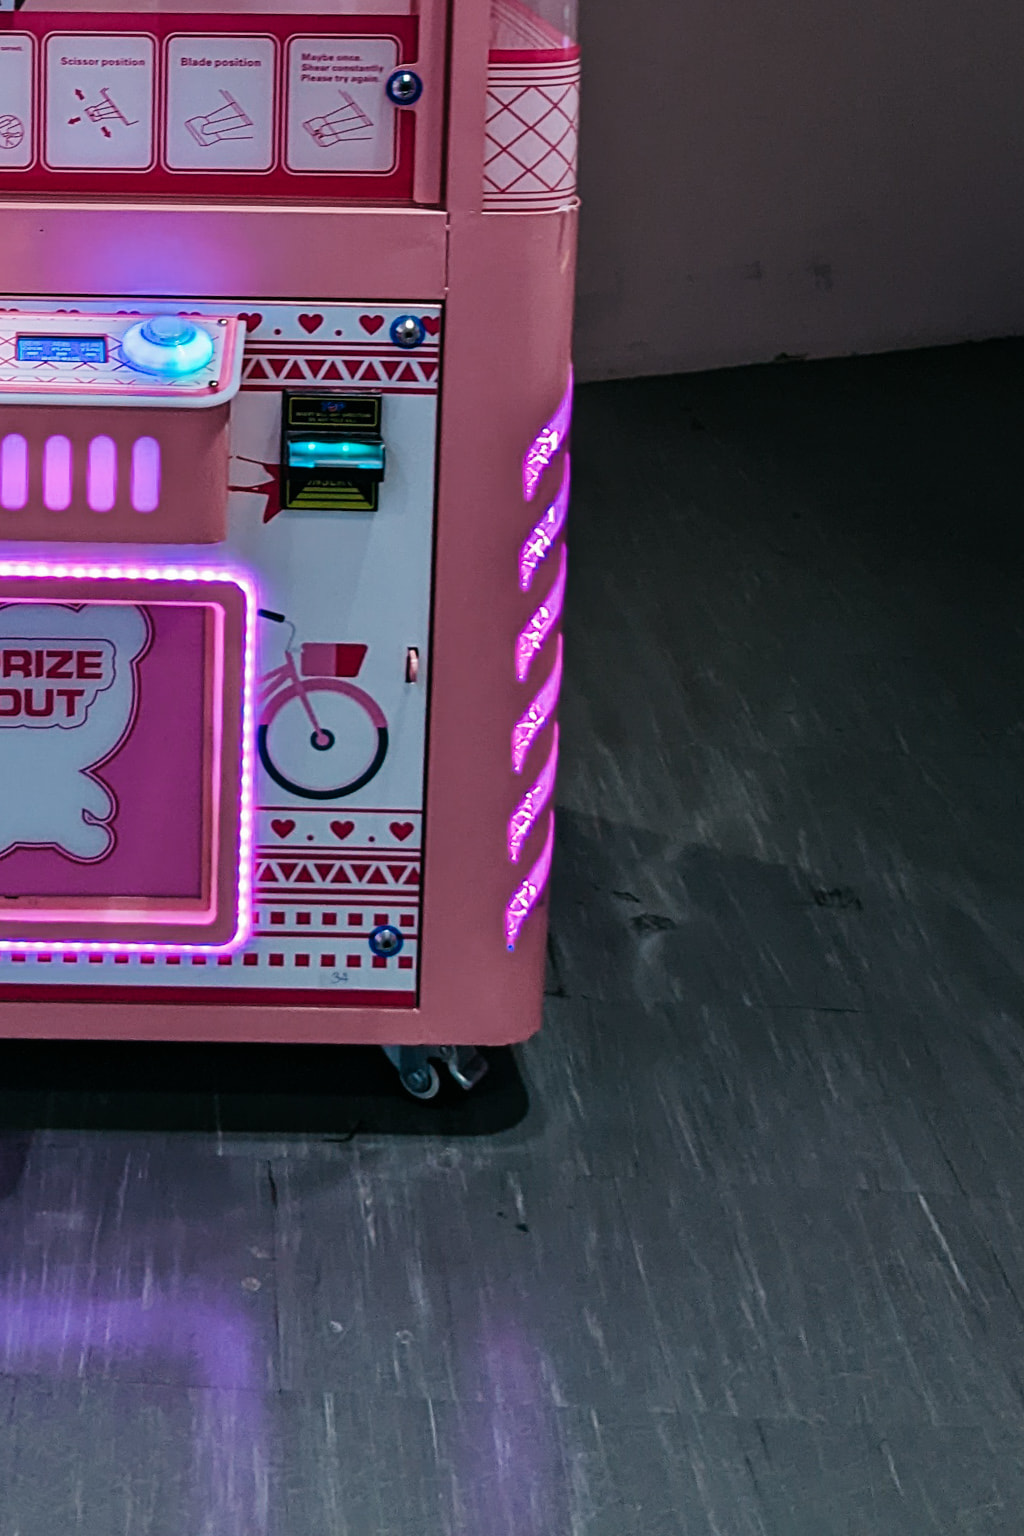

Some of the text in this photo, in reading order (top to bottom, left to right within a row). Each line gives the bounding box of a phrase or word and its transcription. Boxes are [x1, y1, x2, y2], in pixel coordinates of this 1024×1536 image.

[61, 56, 145, 68] Scissor position
[181, 57, 262, 69] Blade position
